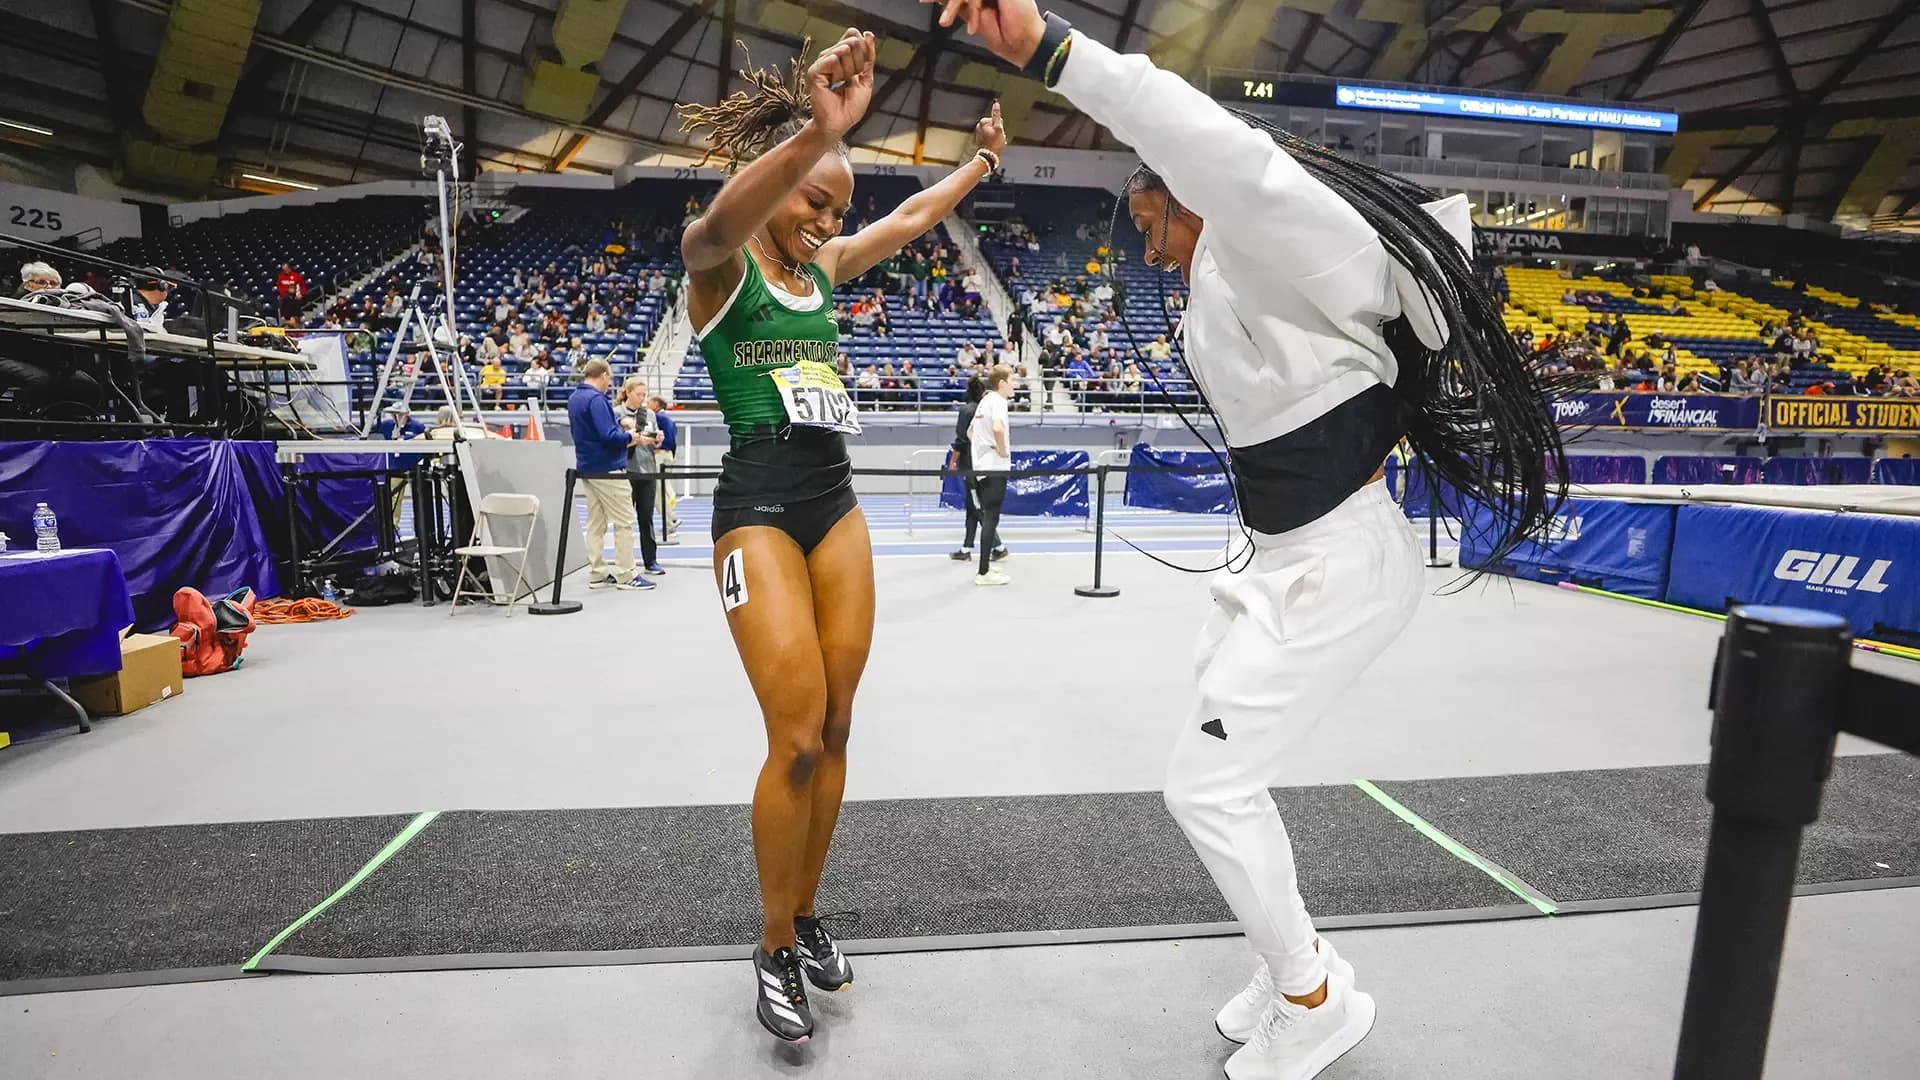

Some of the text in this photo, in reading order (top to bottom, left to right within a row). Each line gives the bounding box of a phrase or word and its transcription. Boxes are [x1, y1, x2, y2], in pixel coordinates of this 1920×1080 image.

[1243, 81, 1273, 98] 7.41
[1460, 99, 1661, 128] Official Health Care Partner of NAU Athletics
[1034, 166, 1056, 179] 217
[9, 205, 63, 231] 225
[734, 340, 824, 368] SACRAMENTO
[1650, 395, 1687, 409] desert
[1776, 401, 1920, 427] OFFICIAL STUDEN
[1652, 408, 1718, 424] FINANCIAL
[726, 554, 742, 604] 4
[1774, 549, 1893, 593] GILL
[1805, 585, 1848, 596] MADE IN USA
